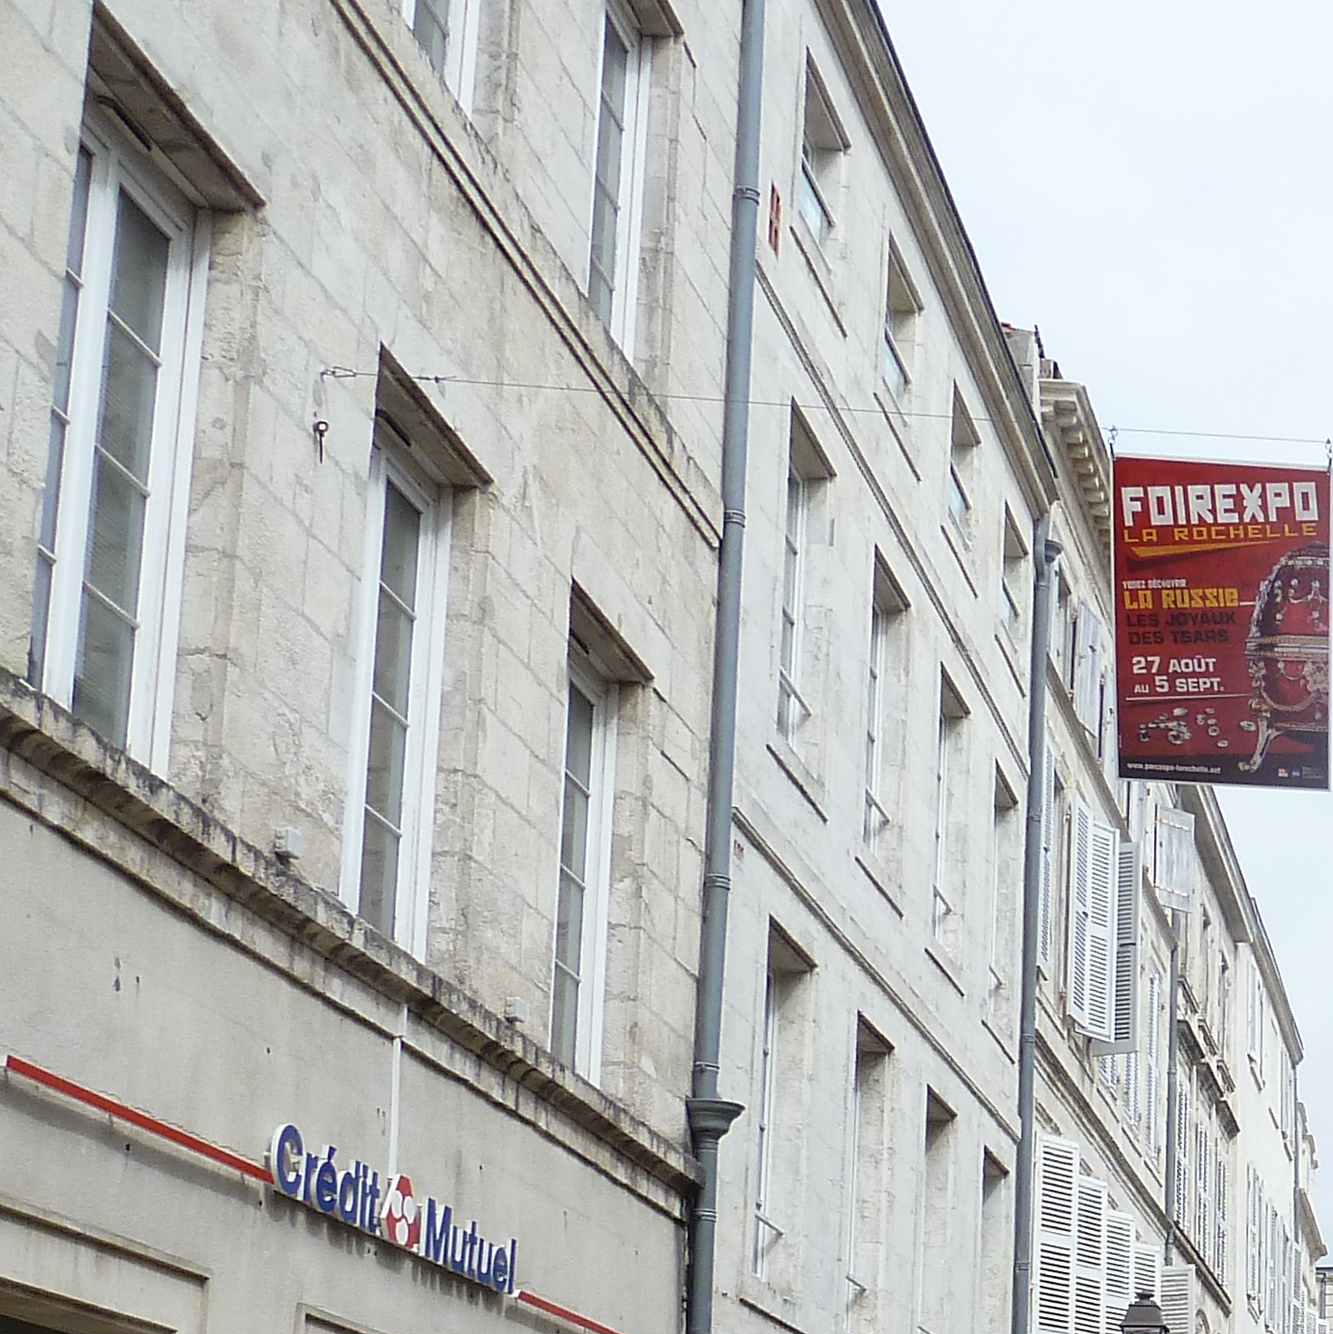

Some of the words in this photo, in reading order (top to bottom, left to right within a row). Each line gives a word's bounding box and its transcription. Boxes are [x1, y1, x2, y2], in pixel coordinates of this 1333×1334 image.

[1120, 481, 1320, 527] FOIREXPO
[1123, 527, 1158, 543] LA
[1166, 522, 1318, 541] ROCHELLE
[1123, 590, 1154, 610] LA
[1127, 613, 1160, 628] LES
[1166, 611, 1237, 627] JOYAUX
[1128, 630, 1164, 645] DES
[1170, 629, 1229, 645] TSARS
[1132, 656, 1161, 674] 27
[1168, 655, 1217, 673] AOÛT
[1133, 683, 1150, 694] AU
[1154, 675, 1170, 694] 5
[1175, 676, 1225, 694] SEPT.
[271, 1123, 382, 1236] Crédit
[420, 1196, 518, 1295] Mutuel
